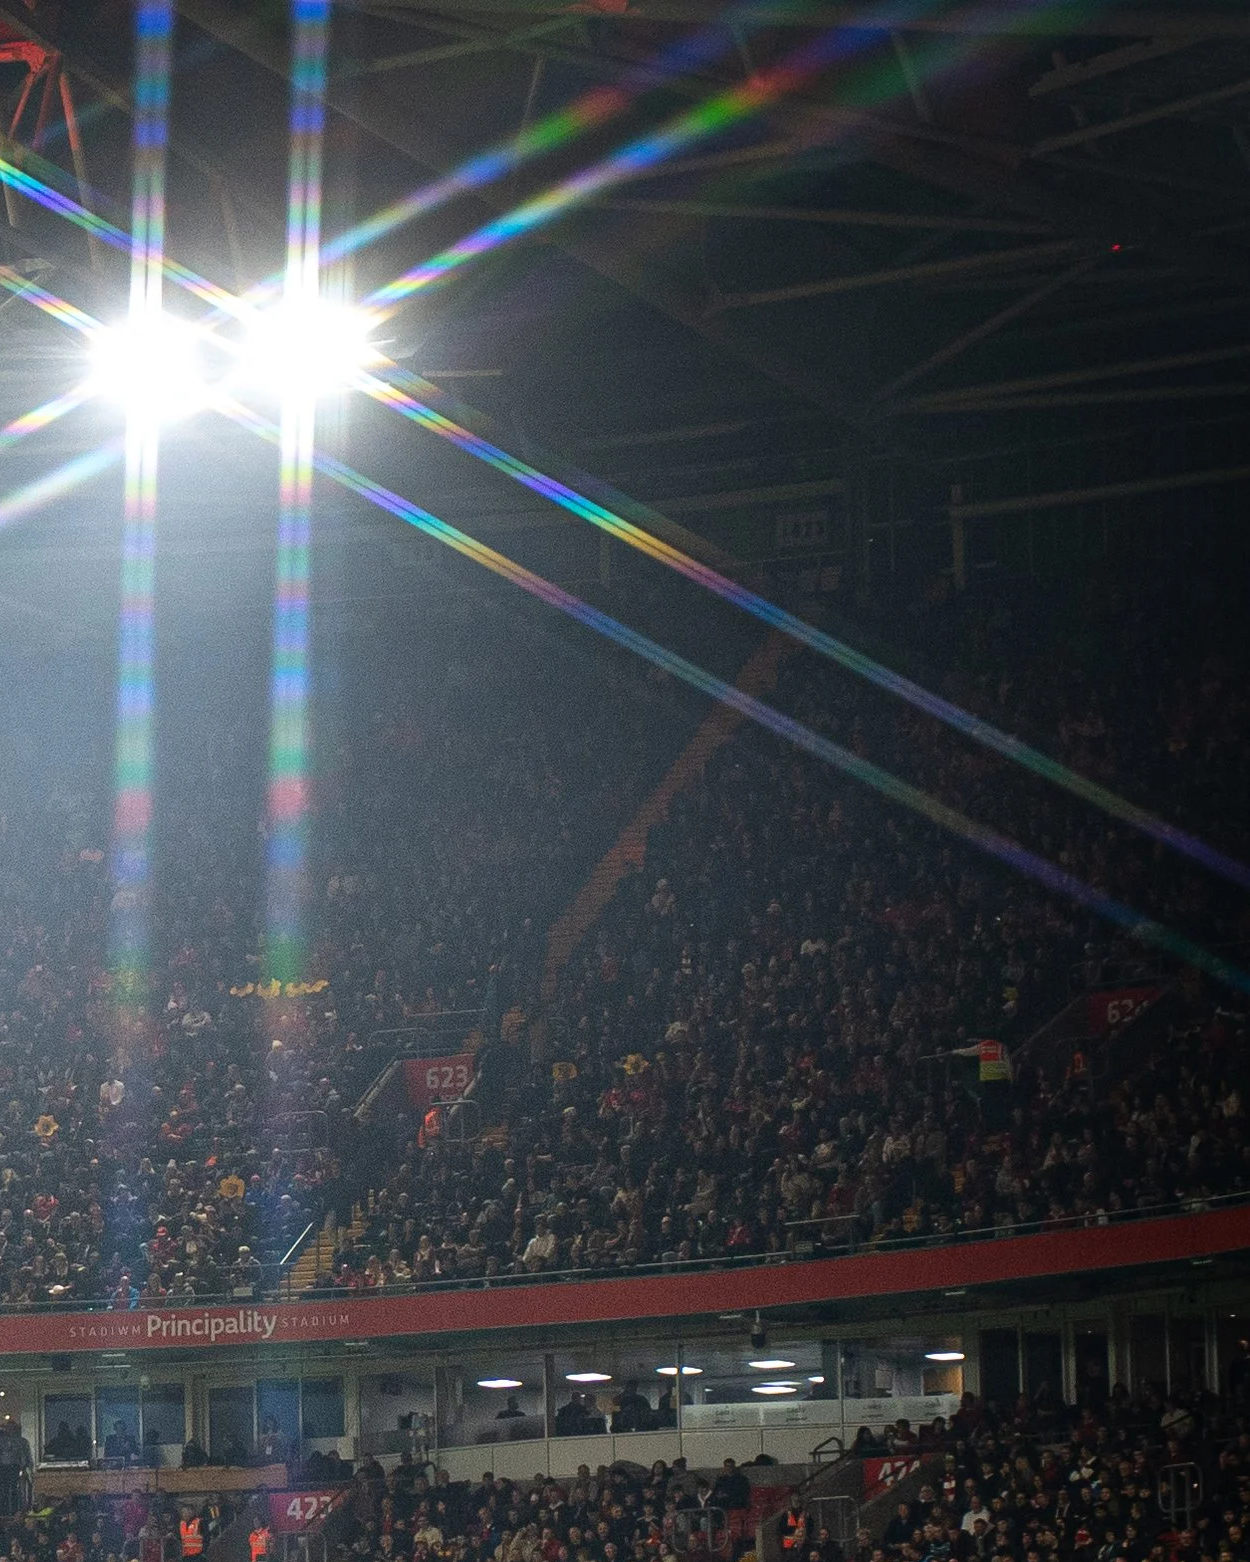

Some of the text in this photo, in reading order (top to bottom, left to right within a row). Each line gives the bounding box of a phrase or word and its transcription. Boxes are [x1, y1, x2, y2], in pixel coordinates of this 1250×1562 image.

[426, 1065, 469, 1090] 623
[146, 1311, 278, 1341] Principality
[280, 1314, 350, 1328] STADIUM
